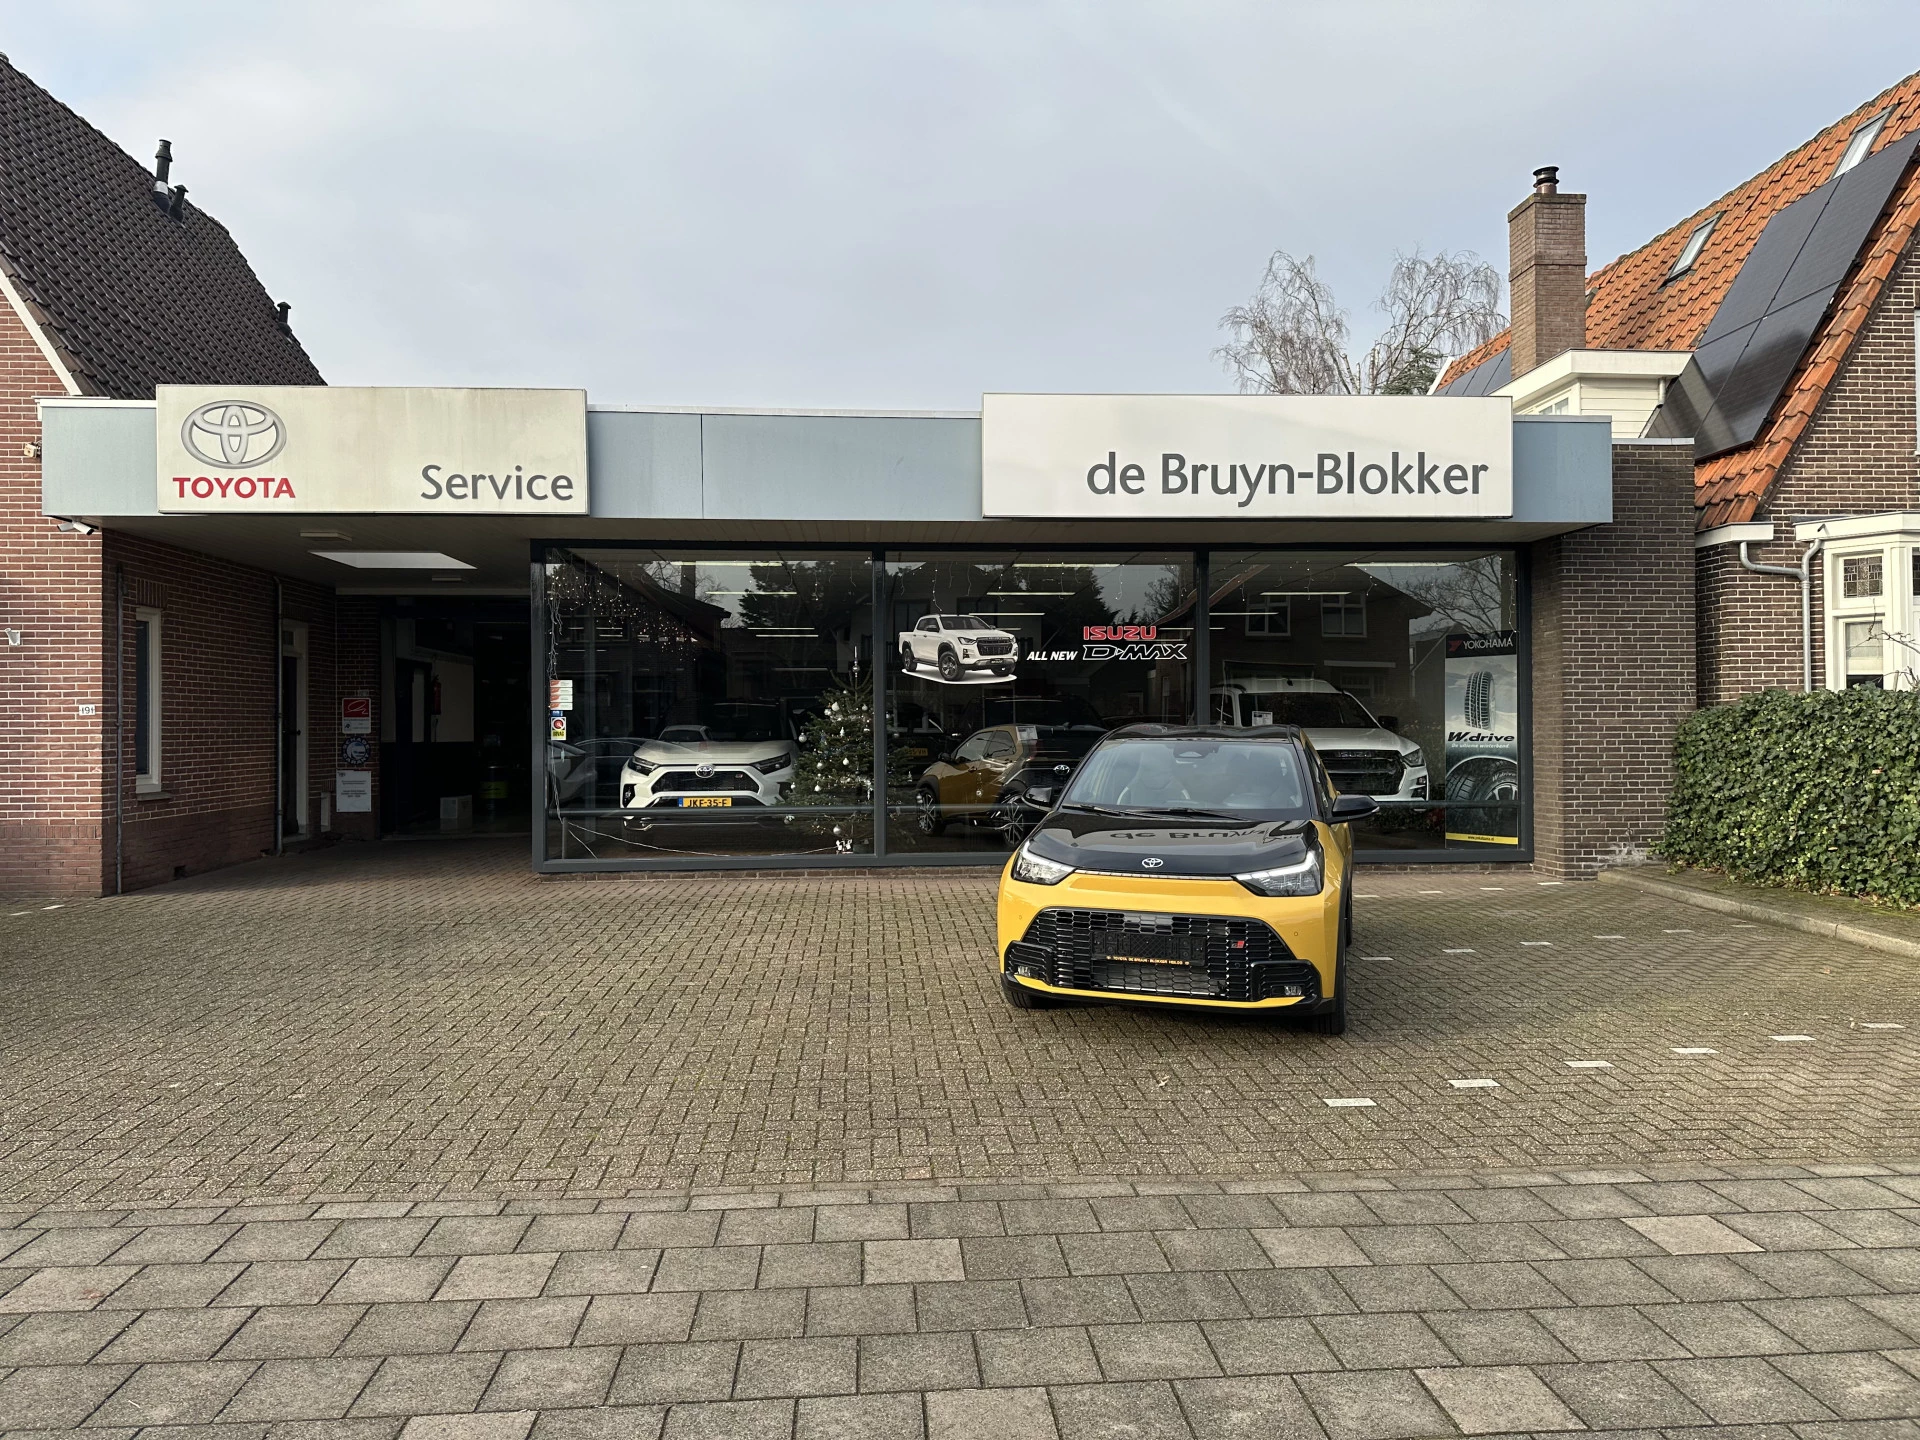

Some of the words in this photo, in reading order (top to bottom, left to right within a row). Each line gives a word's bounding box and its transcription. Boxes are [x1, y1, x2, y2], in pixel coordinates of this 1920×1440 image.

[172, 476, 296, 498] TOYOTA
[420, 464, 574, 501] Service
[1086, 451, 1146, 495] de
[1160, 451, 1490, 508] Bruyn-Blokker
[1083, 625, 1157, 641] ISUZU
[1463, 638, 1513, 650] YOKOHAMA
[1027, 651, 1048, 661] ALL
[1050, 651, 1078, 661] NEW
[1447, 732, 1515, 742] W.drive
